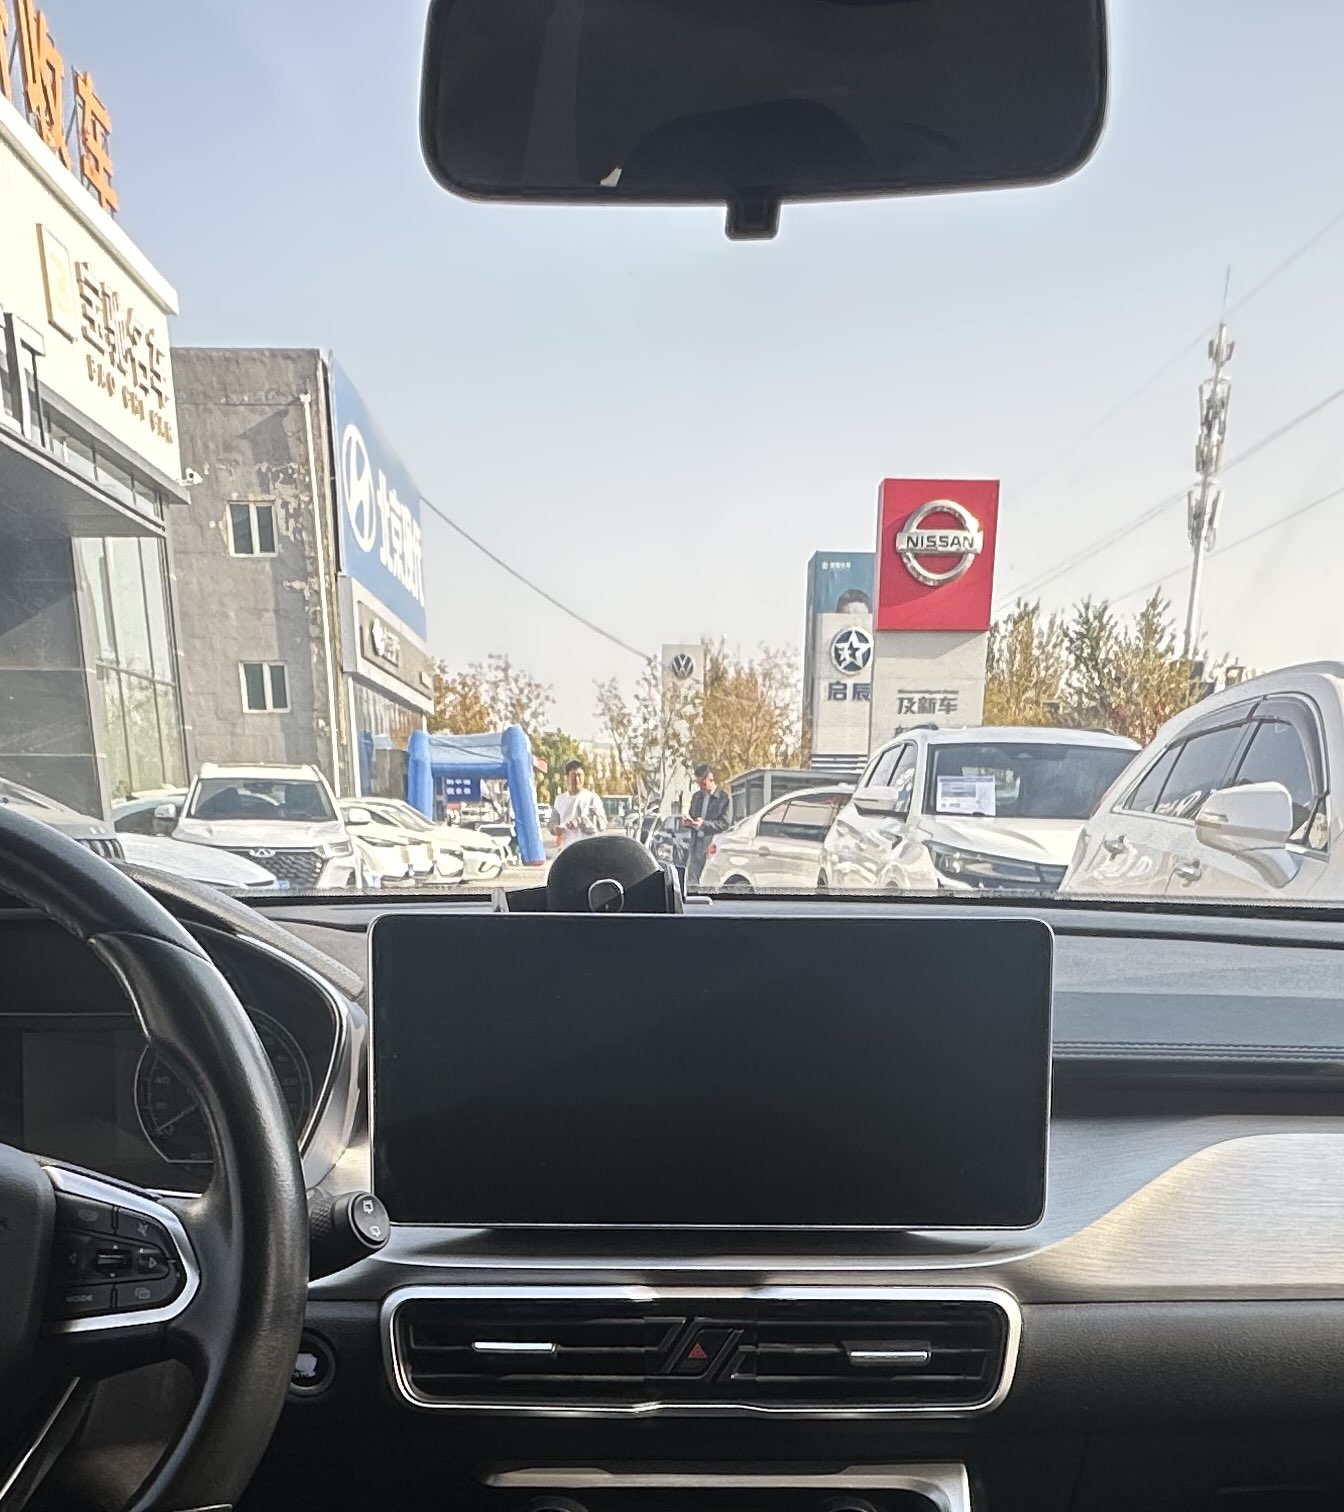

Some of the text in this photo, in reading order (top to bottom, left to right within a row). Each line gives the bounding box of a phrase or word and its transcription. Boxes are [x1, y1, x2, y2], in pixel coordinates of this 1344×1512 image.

[906, 534, 975, 549] NISSAN
[827, 681, 871, 701] 启辰
[896, 696, 959, 714] 及新车
